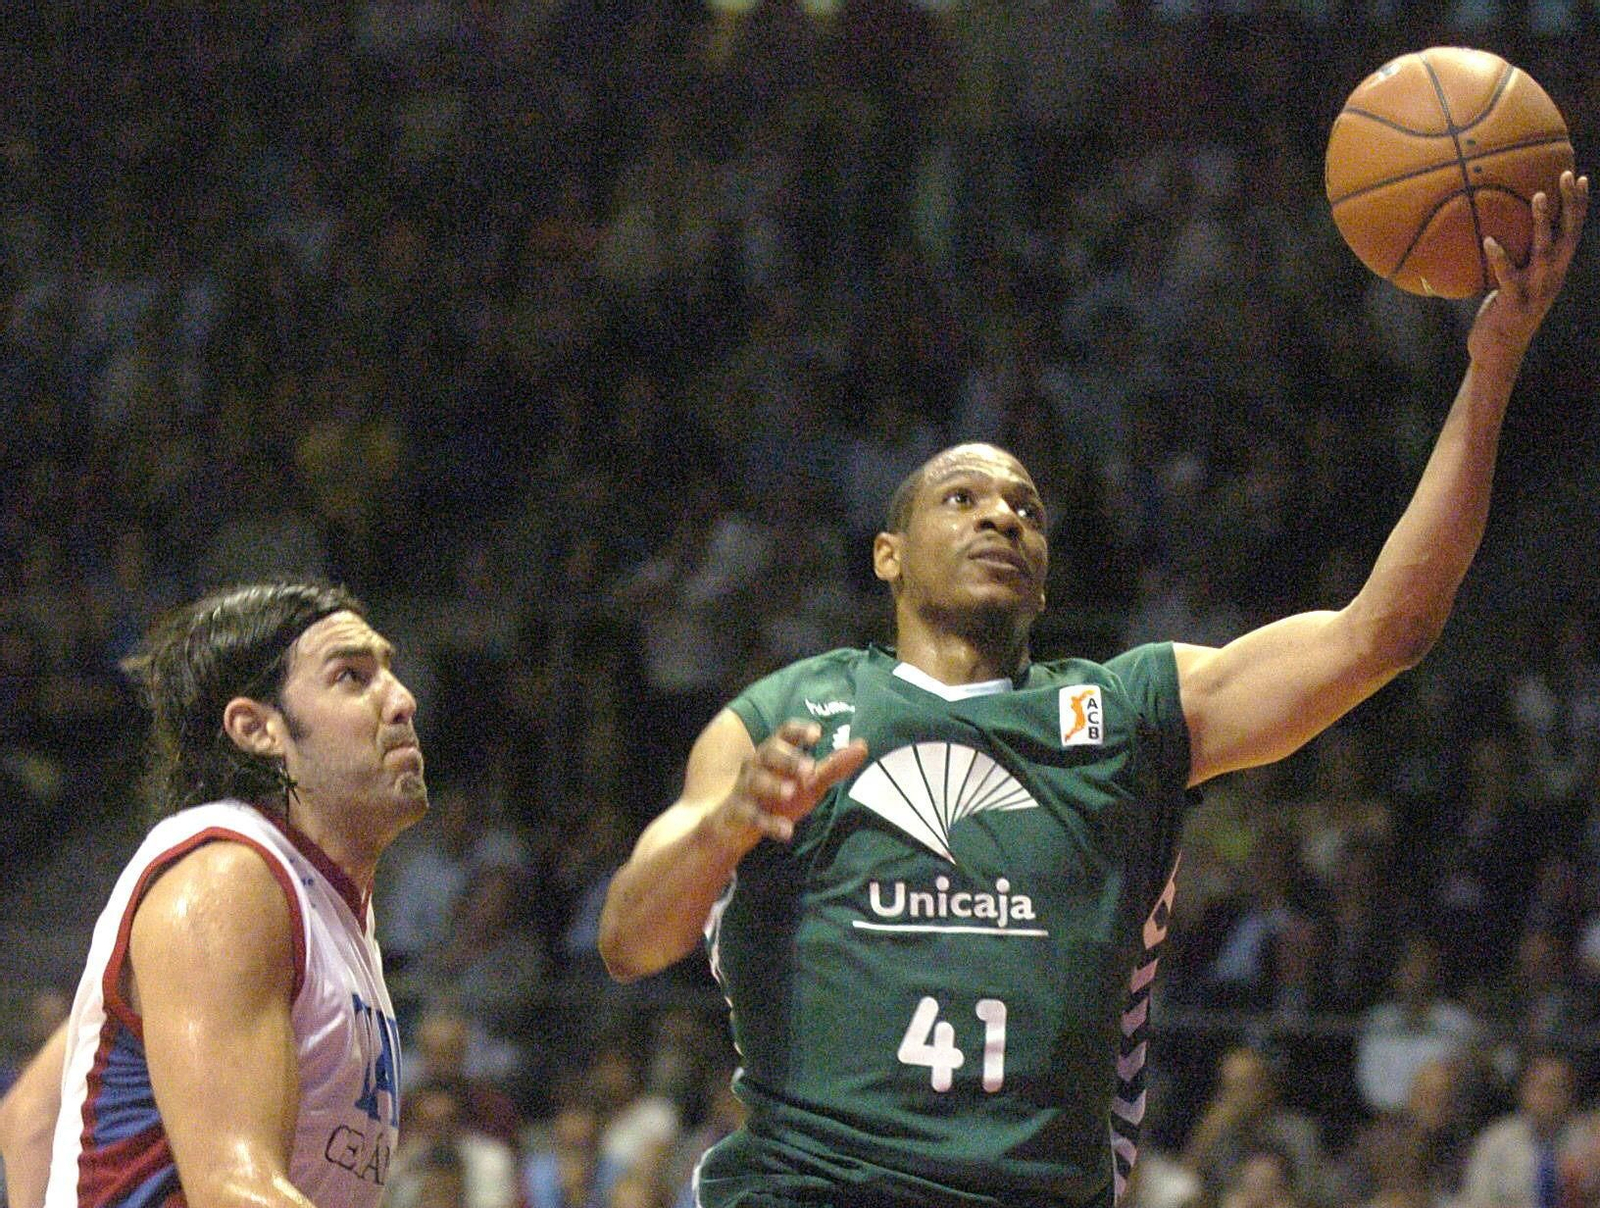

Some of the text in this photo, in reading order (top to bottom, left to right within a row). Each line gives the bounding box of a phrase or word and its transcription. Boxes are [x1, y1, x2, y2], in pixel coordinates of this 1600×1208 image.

[1086, 697, 1100, 740] ACB
[868, 876, 1036, 928] Unicaja
[897, 996, 1006, 1092] 41
